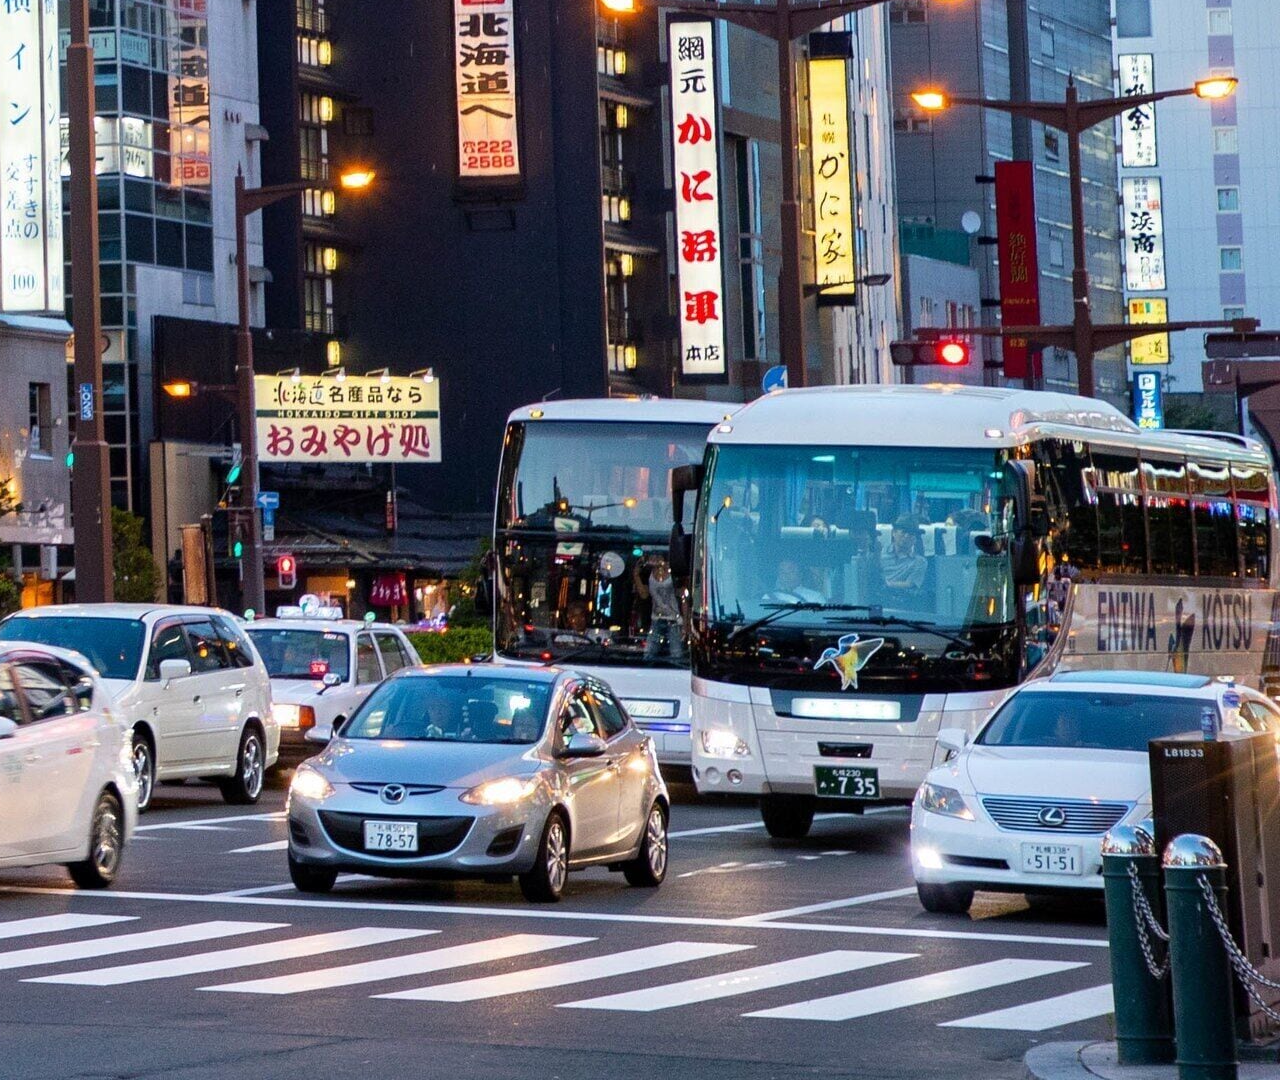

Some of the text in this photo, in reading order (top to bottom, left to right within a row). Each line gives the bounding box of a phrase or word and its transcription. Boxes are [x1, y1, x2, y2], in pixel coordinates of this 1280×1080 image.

[677, 36, 707, 94] 網元
[4, 160, 22, 240] 交差点
[23, 153, 39, 240] すすきの
[817, 151, 847, 264] かに家
[676, 111, 719, 324] かに将軍
[10, 275, 36, 291] 100
[685, 343, 721, 362] 本店
[273, 379, 423, 406] 北海道名産品なら
[385, 409, 417, 419] SHOP
[266, 423, 431, 458] おみやげ処
[1097, 589, 1157, 653] ENIWA
[1164, 747, 1205, 758] LB1833
[376, 832, 415, 848] 78-57
[1034, 856, 1074, 870] 51-51
